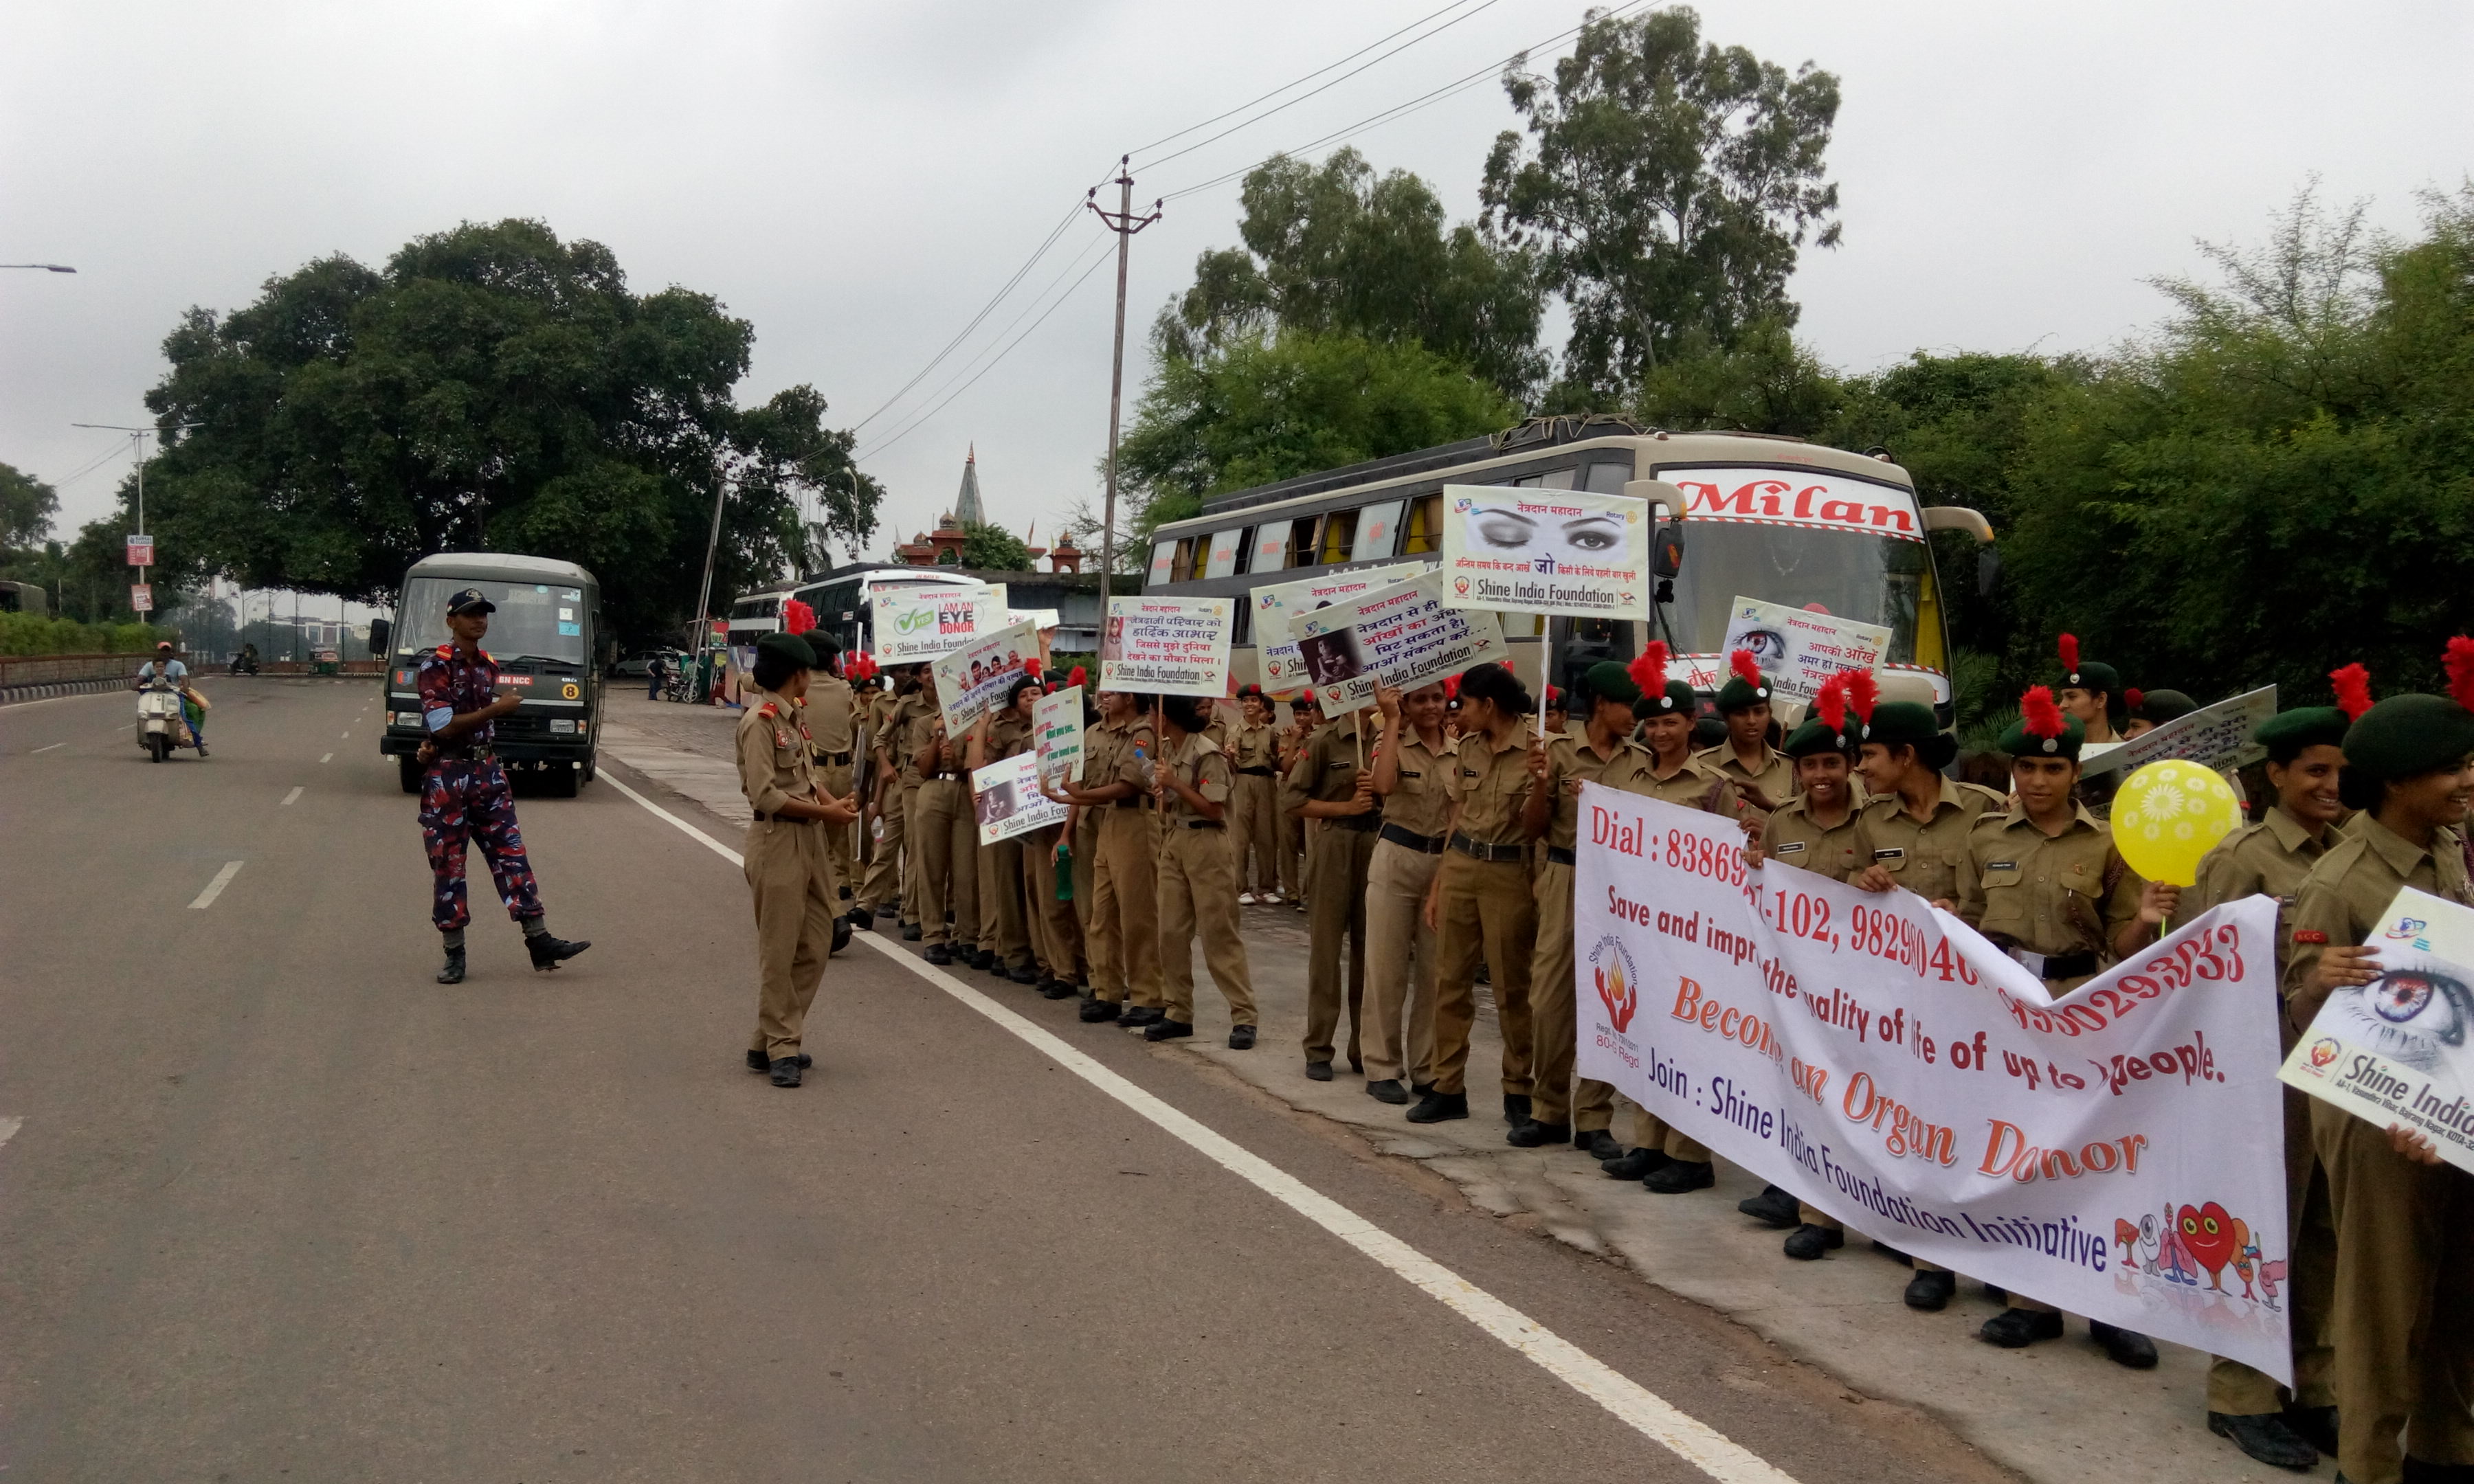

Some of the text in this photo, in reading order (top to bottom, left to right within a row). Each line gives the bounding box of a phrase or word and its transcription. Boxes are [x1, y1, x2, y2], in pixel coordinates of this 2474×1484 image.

[1517, 501, 1583, 517] नेत्रदान महादान
[1606, 511, 1625, 520] Rotary
[1678, 480, 1915, 532] Milan
[1456, 556, 1475, 568] अन्तिम
[1477, 560, 1491, 570] समय
[1502, 563, 1514, 572] बन्द
[1535, 552, 1555, 575] जो
[1558, 563, 1573, 575] किसी
[1574, 564, 1581, 575] के
[1582, 565, 1594, 576] लिये
[1596, 567, 1611, 578] पहली
[1612, 570, 1621, 579] बार
[1623, 570, 1636, 583] खुली
[1311, 583, 1367, 597] नेत्रदान महादान
[1478, 578, 1511, 596] Shine
[1515, 581, 1545, 598] India
[1550, 584, 1614, 603] Foundation
[939, 602, 973, 612] I AM AN
[1357, 590, 1418, 616] नेत्रदान महादान
[917, 613, 931, 624] YES!
[939, 611, 974, 623] EYE
[1166, 616, 1204, 627] परिवार
[1206, 618, 1222, 627] को
[1357, 600, 1439, 633] नेत्रदान से ही
[1787, 616, 1837, 636] नेत्रदान महादान
[940, 622, 974, 634] DONOR
[1133, 625, 1218, 640] हार्दिक आभार
[1363, 618, 1427, 646] आँखों का
[898, 642, 919, 653] Shine
[921, 640, 941, 650] India
[1136, 639, 1212, 653] जिससे मुझे दुनिया
[1375, 640, 1402, 655] मिट
[1404, 625, 1447, 645] सकता
[1403, 638, 1447, 660] संकल्प
[1809, 642, 1842, 657] आपकी
[1127, 651, 1147, 662] देखने
[1190, 655, 1215, 664] मिला
[1266, 646, 1293, 656] नेत्रदान
[1380, 668, 1409, 686] India
[1411, 645, 1471, 675] Foundation
[1797, 653, 1834, 671] अमर हो
[499, 675, 530, 684] BN NCC
[1117, 664, 1200, 680] Shine India Foundation
[566, 686, 575, 697] 8
[1773, 675, 1797, 692] India
[961, 705, 976, 721] Shine
[2128, 723, 2196, 756] नेत्रदान महादान
[1005, 818, 1025, 831] Shine
[1027, 809, 1049, 823] India
[1592, 805, 1644, 857] Dial
[1589, 941, 1604, 965] Shine
[1615, 935, 1638, 985] Foundation
[1609, 884, 2225, 1096] Save and impr the of life of up to people.
[1596, 1034, 1639, 1069] 80-G Regd
[1671, 976, 2148, 1183] Becom an Organ Donor
[2344, 1054, 2474, 1137] Shine India
[2382, 1098, 2399, 1114] Vihar,
[2398, 1106, 2425, 1127] Bajrang
[2425, 1120, 2446, 1138] Nagar,
[1649, 1046, 1687, 1099] Join
[1710, 1076, 1773, 1139] Shine
[1781, 1108, 1820, 1176] India
[1822, 1143, 1967, 1239] Foundation
[1960, 1211, 2107, 1272] Initiative
